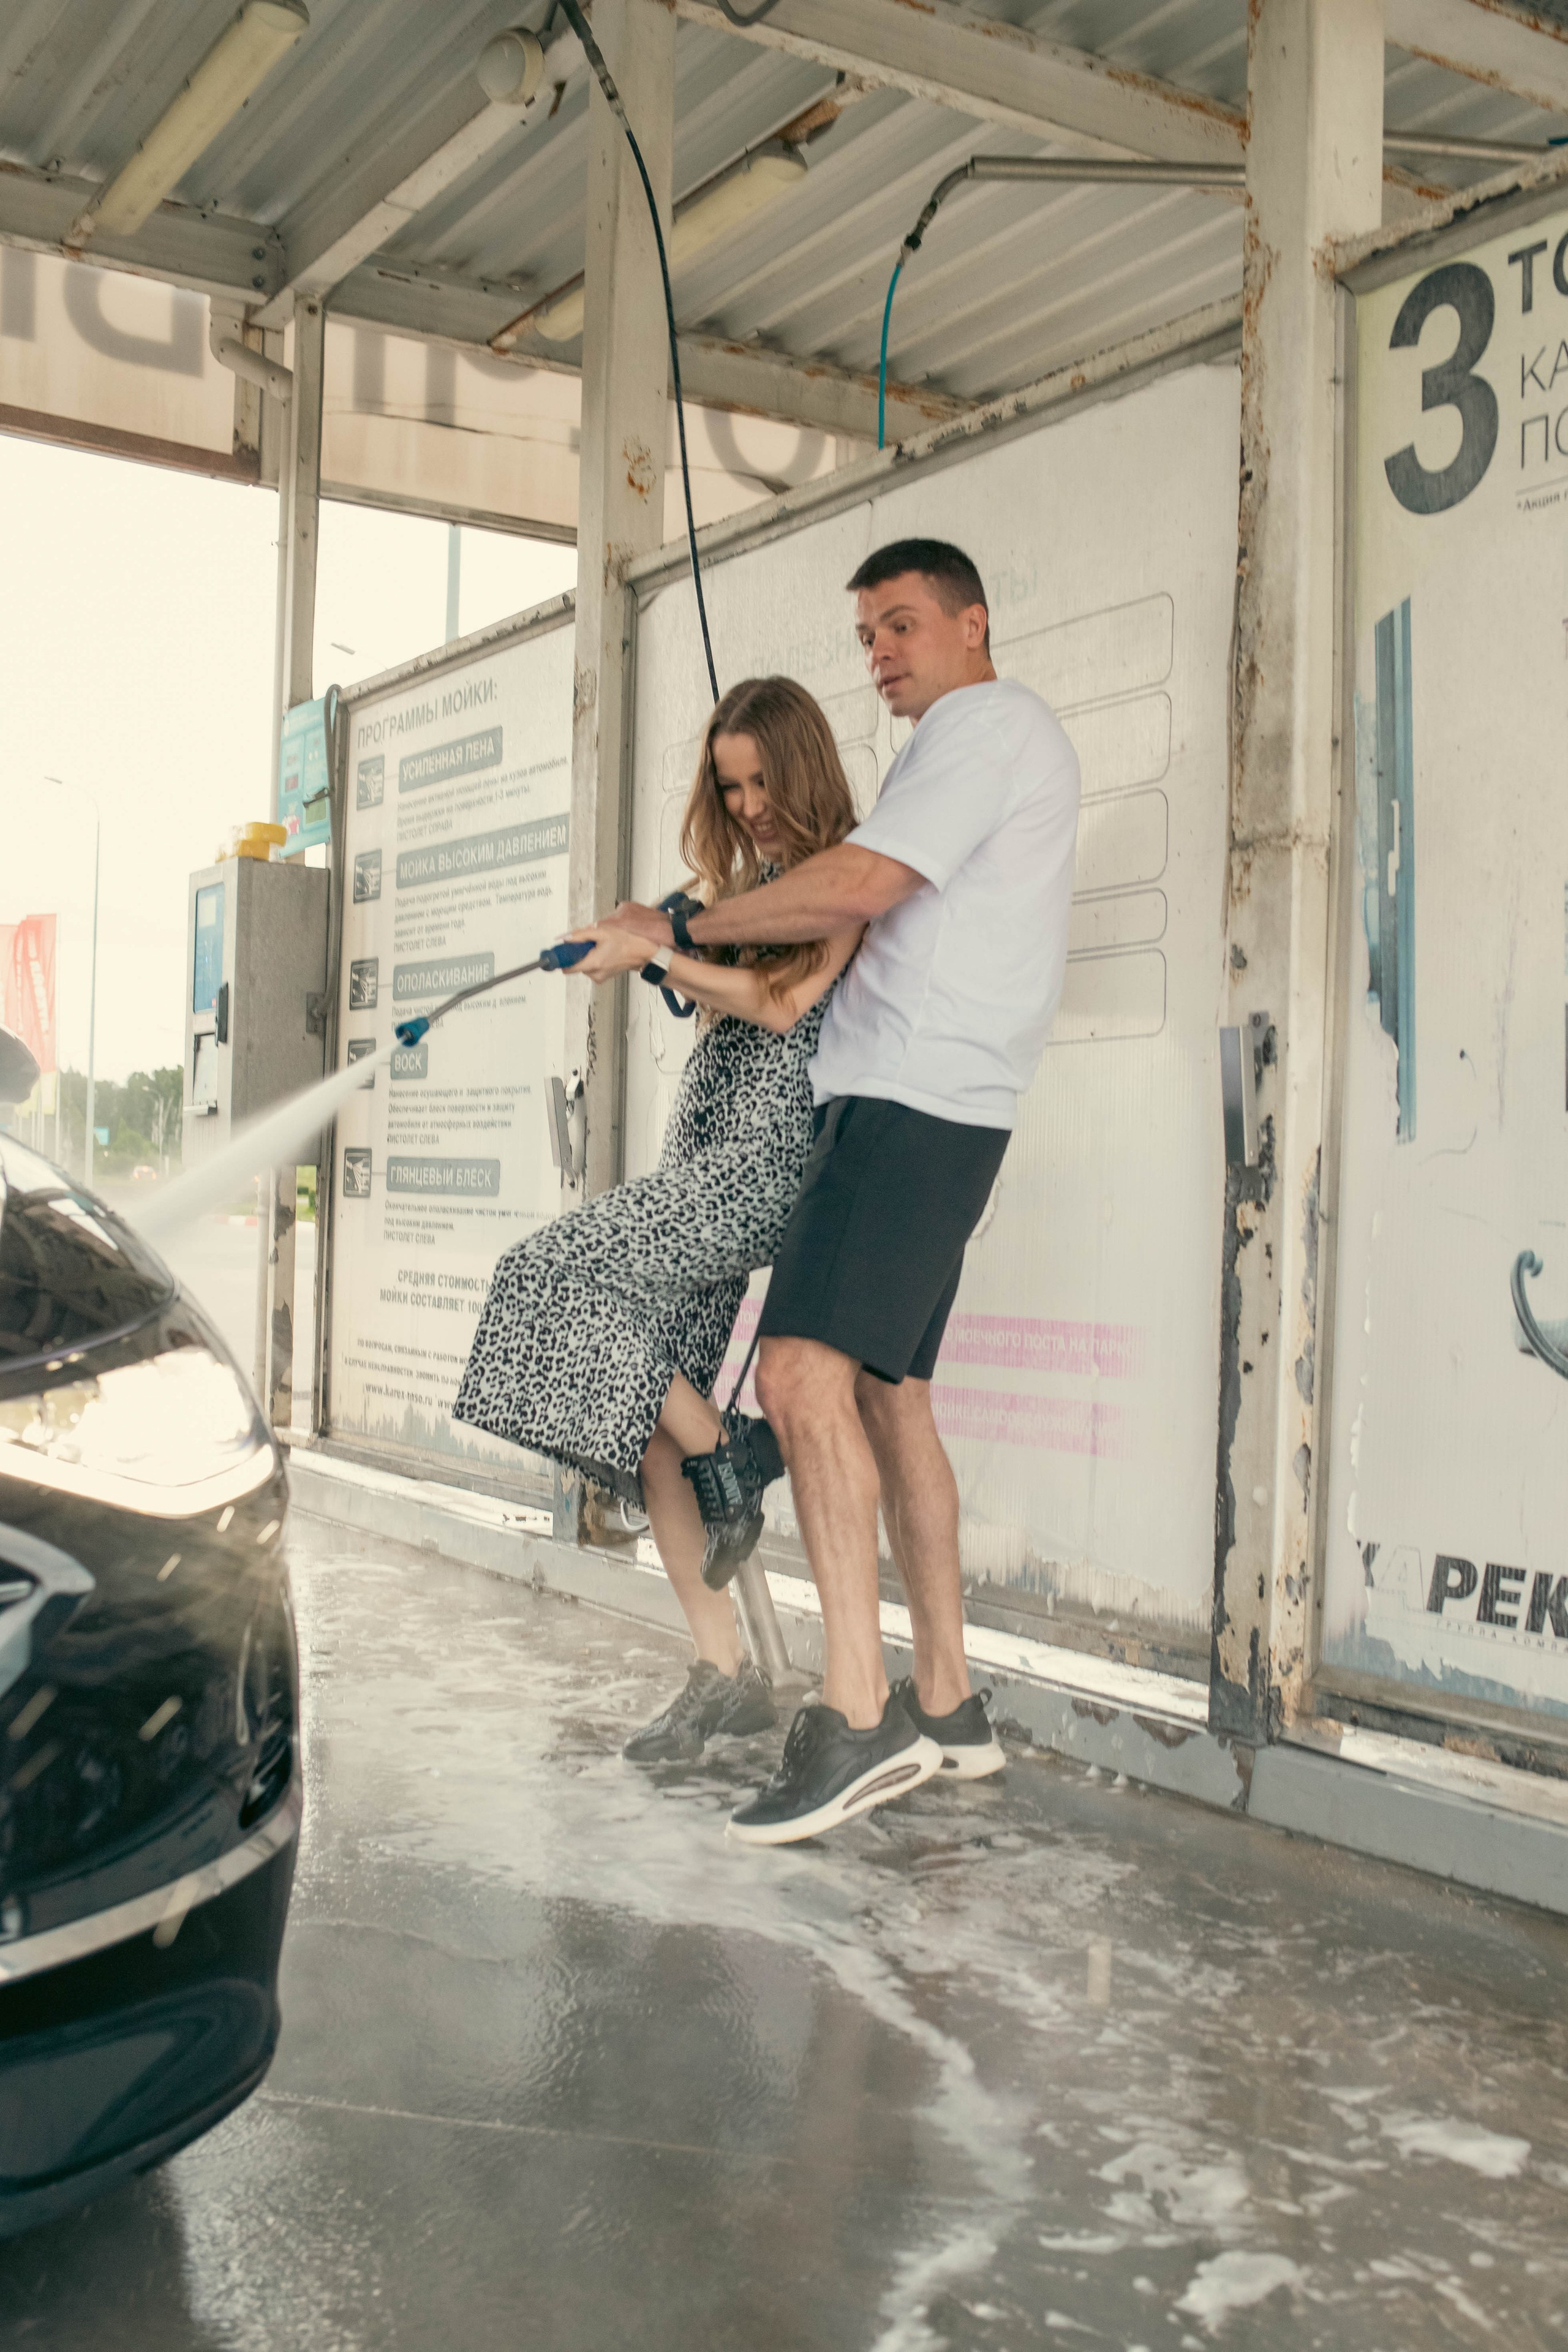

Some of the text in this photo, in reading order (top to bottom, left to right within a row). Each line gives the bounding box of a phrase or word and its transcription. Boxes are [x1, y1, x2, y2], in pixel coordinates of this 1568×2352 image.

[1384, 262, 1499, 514] 3
[358, 699, 438, 748] ПРОГРАММЫ
[442, 679, 498, 718] МОЙКИ:
[402, 736, 494, 782] УСИЛЕННАЯ ПЕНА
[401, 823, 566, 880] МОЙКА ВЫСОКИМ ДАВЛЕНИЕМ
[397, 963, 489, 992] ОПОЛАСКИВАНИЕ
[394, 1052, 422, 1071] ВОСК
[390, 1165, 492, 1188] ГЛЯНЦЕВЫЙ БЛЕСК
[398, 1268, 435, 1288] СРЕДНЯЯ
[380, 1286, 408, 1304] МОЙКИ
[410, 1292, 464, 1312] СОСТАВЛЯЕТ
